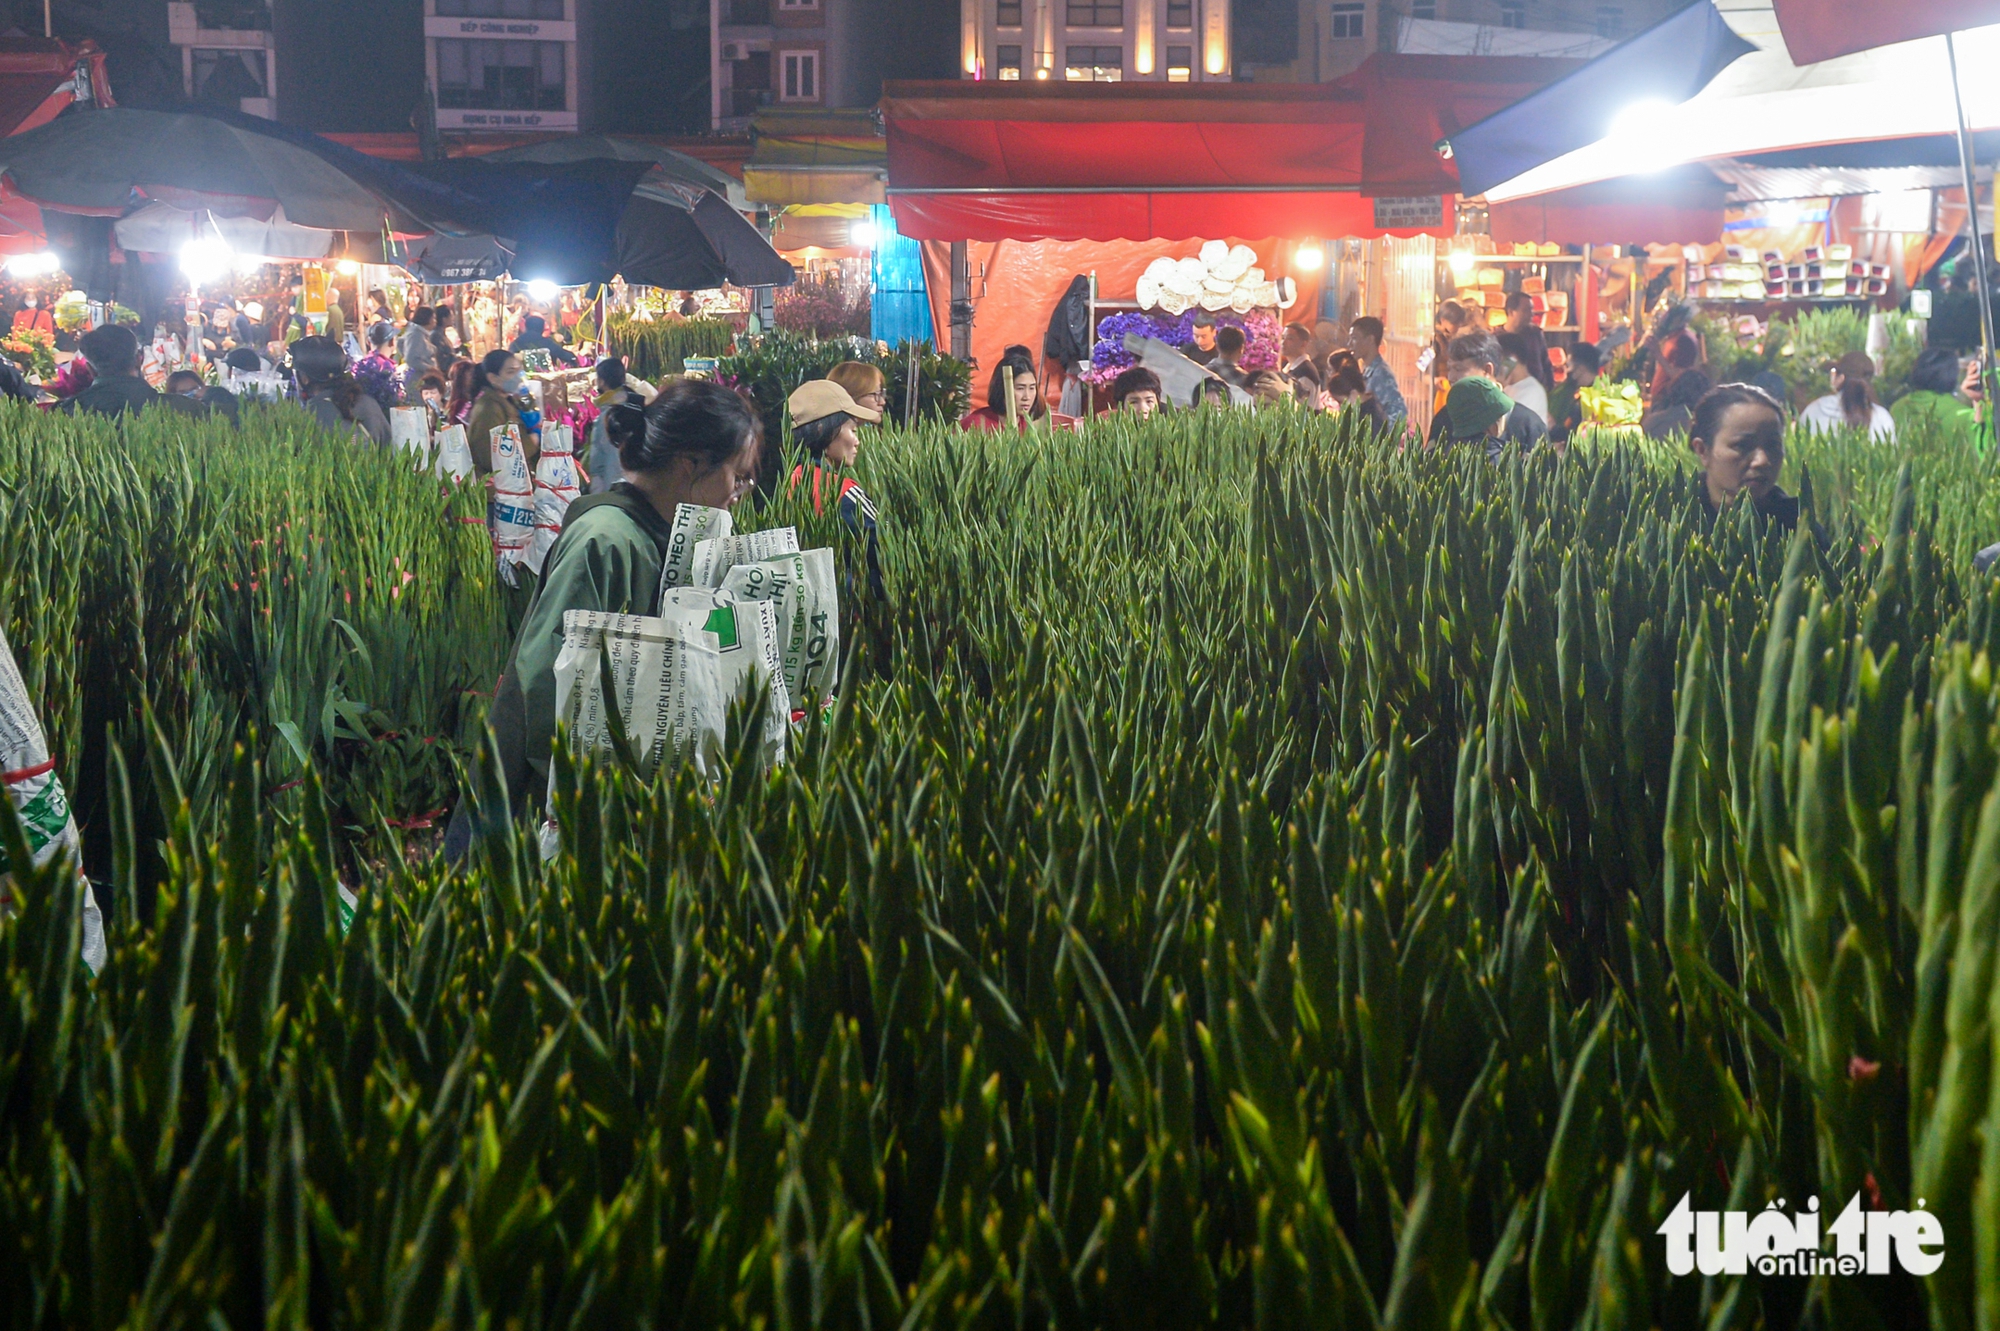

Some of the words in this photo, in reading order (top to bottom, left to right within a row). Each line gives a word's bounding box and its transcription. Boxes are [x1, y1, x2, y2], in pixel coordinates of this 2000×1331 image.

[460, 20, 479, 33] BẾP
[480, 21, 505, 34] CÔNG
[669, 533, 685, 566] HEO
[794, 556, 804, 580] kg)
[796, 584, 805, 603] 30
[792, 608, 804, 632] đến
[612, 642, 622, 658] đến
[662, 638, 674, 669] CHÍNH
[791, 636, 803, 653] kg
[630, 649, 641, 666] quy
[786, 657, 797, 673] 15
[574, 668, 585, 700] 0,4-1,5
[626, 667, 637, 686] theo
[659, 671, 674, 693] LIỆU
[679, 674, 687, 687] cám
[590, 687, 600, 702] 0,8
[624, 685, 635, 705] cấm
[677, 689, 686, 708] tấm,
[588, 702, 598, 722] min:
[622, 705, 633, 725] chất
[655, 695, 669, 736] NGUYÊN
[676, 712, 687, 729] bắp,
[692, 705, 700, 725] sung.
[586, 723, 595, 740] (%)
[652, 738, 665, 766] PHẦN
